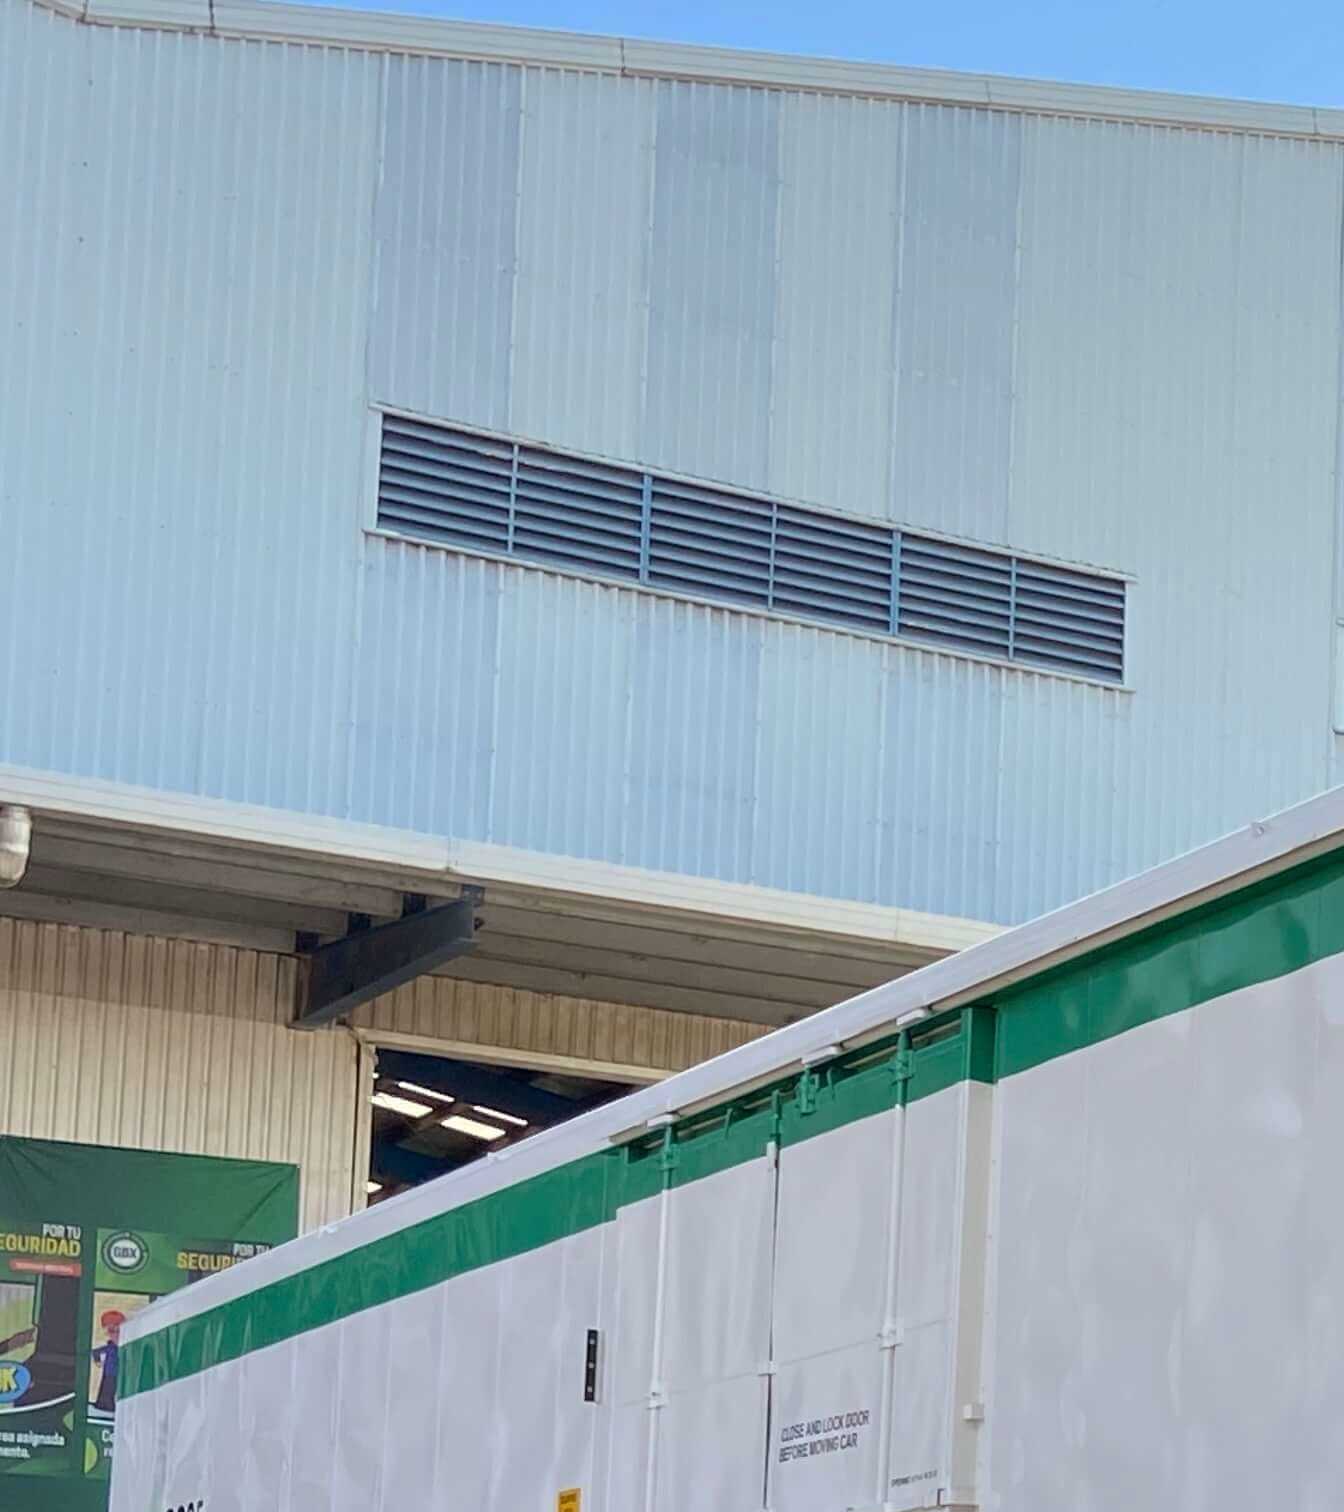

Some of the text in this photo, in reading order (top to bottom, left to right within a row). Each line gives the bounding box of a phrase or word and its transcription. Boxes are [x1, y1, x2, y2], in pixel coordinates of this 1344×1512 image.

[781, 1410, 869, 1442] CLOSE AND LOCK DOOR
[779, 1443, 809, 1463] BEFORE
[840, 1432, 858, 1449] CAR
